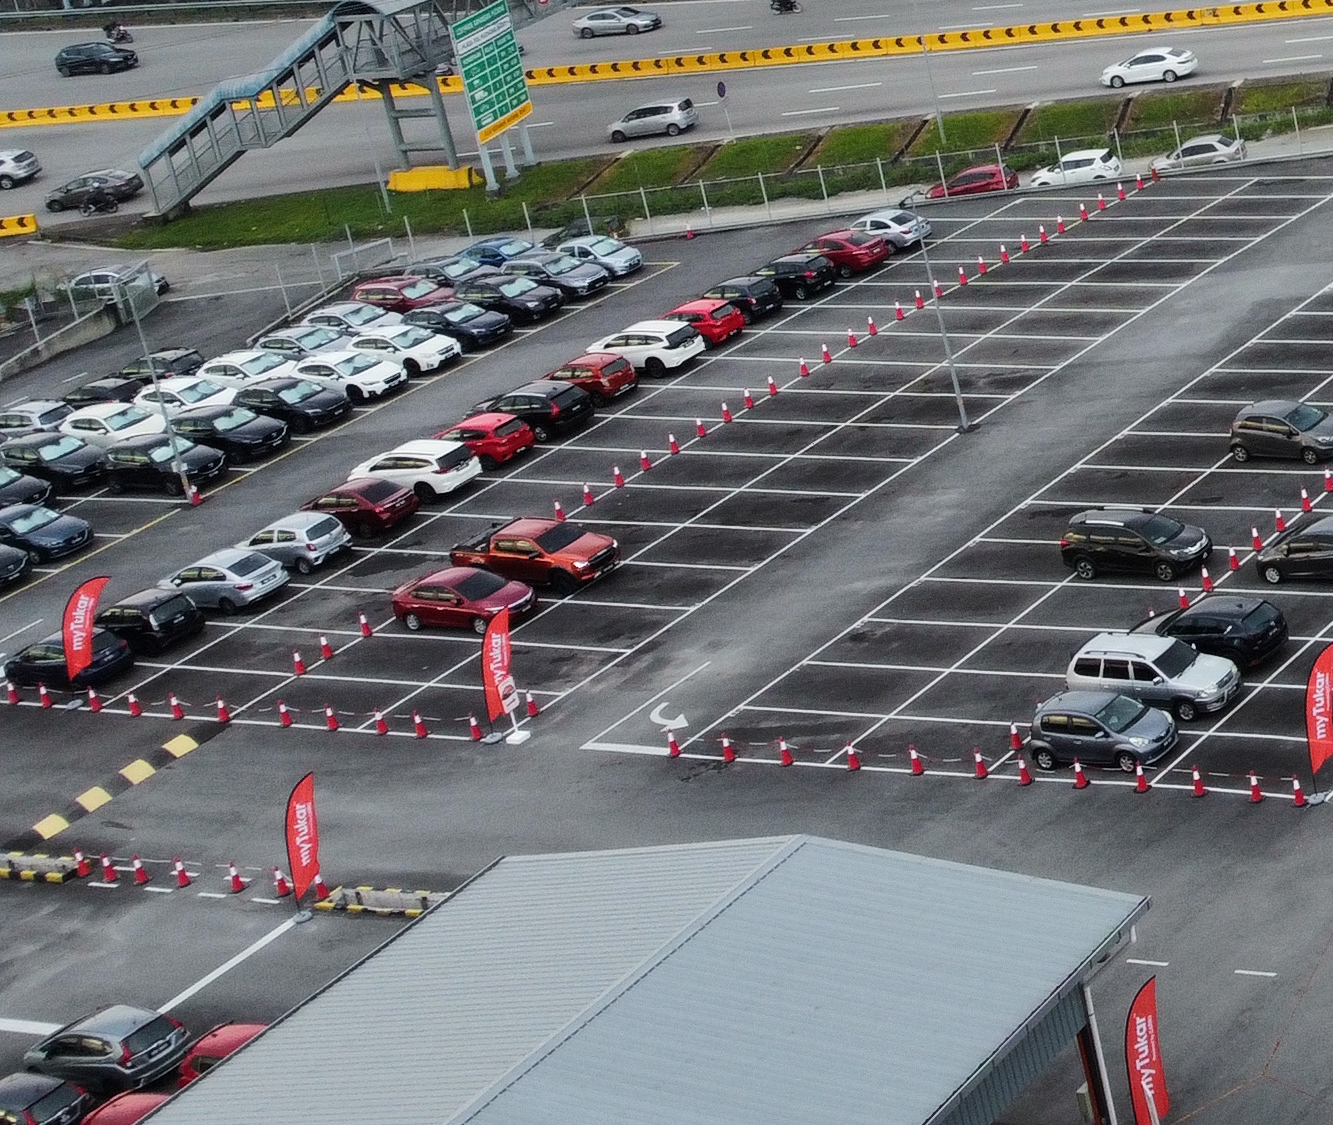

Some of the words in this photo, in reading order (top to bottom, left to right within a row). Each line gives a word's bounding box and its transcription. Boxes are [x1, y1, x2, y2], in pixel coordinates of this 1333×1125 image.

[70, 593, 91, 652] myTukar
[1312, 671, 1330, 740] myTukar
[293, 801, 313, 867] myTukar
